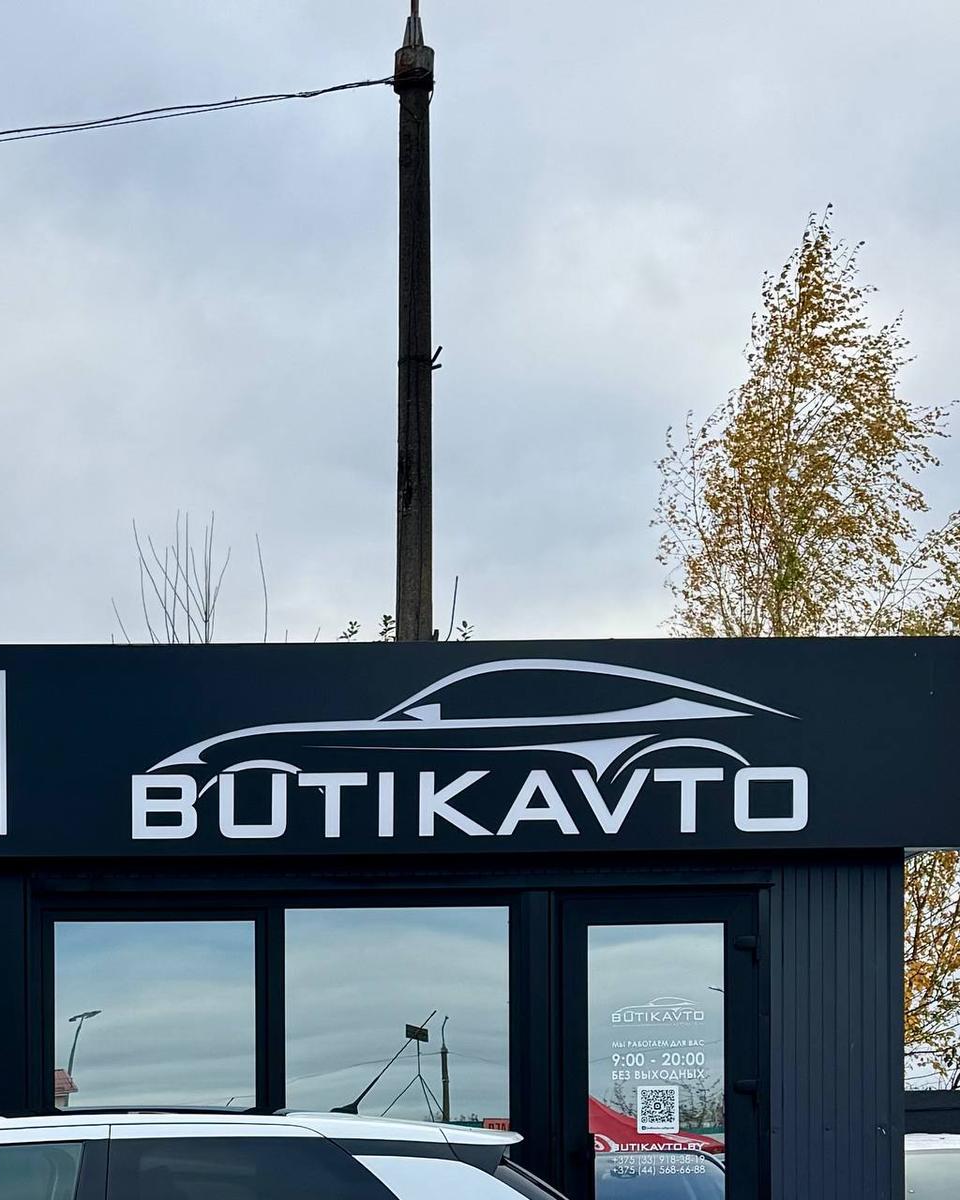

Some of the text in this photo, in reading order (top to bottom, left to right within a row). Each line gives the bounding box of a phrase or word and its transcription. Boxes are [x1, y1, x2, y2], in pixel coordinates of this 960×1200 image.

[131, 766, 808, 839] BUTIKAVTO
[611, 1011, 705, 1023] BUTIKAVTO
[612, 1040, 626, 1048] МЫ
[627, 1040, 669, 1048] РАБОТАЕМ
[611, 1053, 645, 1067] 9:00
[661, 1052, 705, 1066] 20:00
[611, 1069, 705, 1081] БЕЗ ВЫХОДНЫХ
[612, 1155, 706, 1166] +375 (33) 918-38-19
[612, 1165, 706, 1176] +375 (44) 568-66-88
